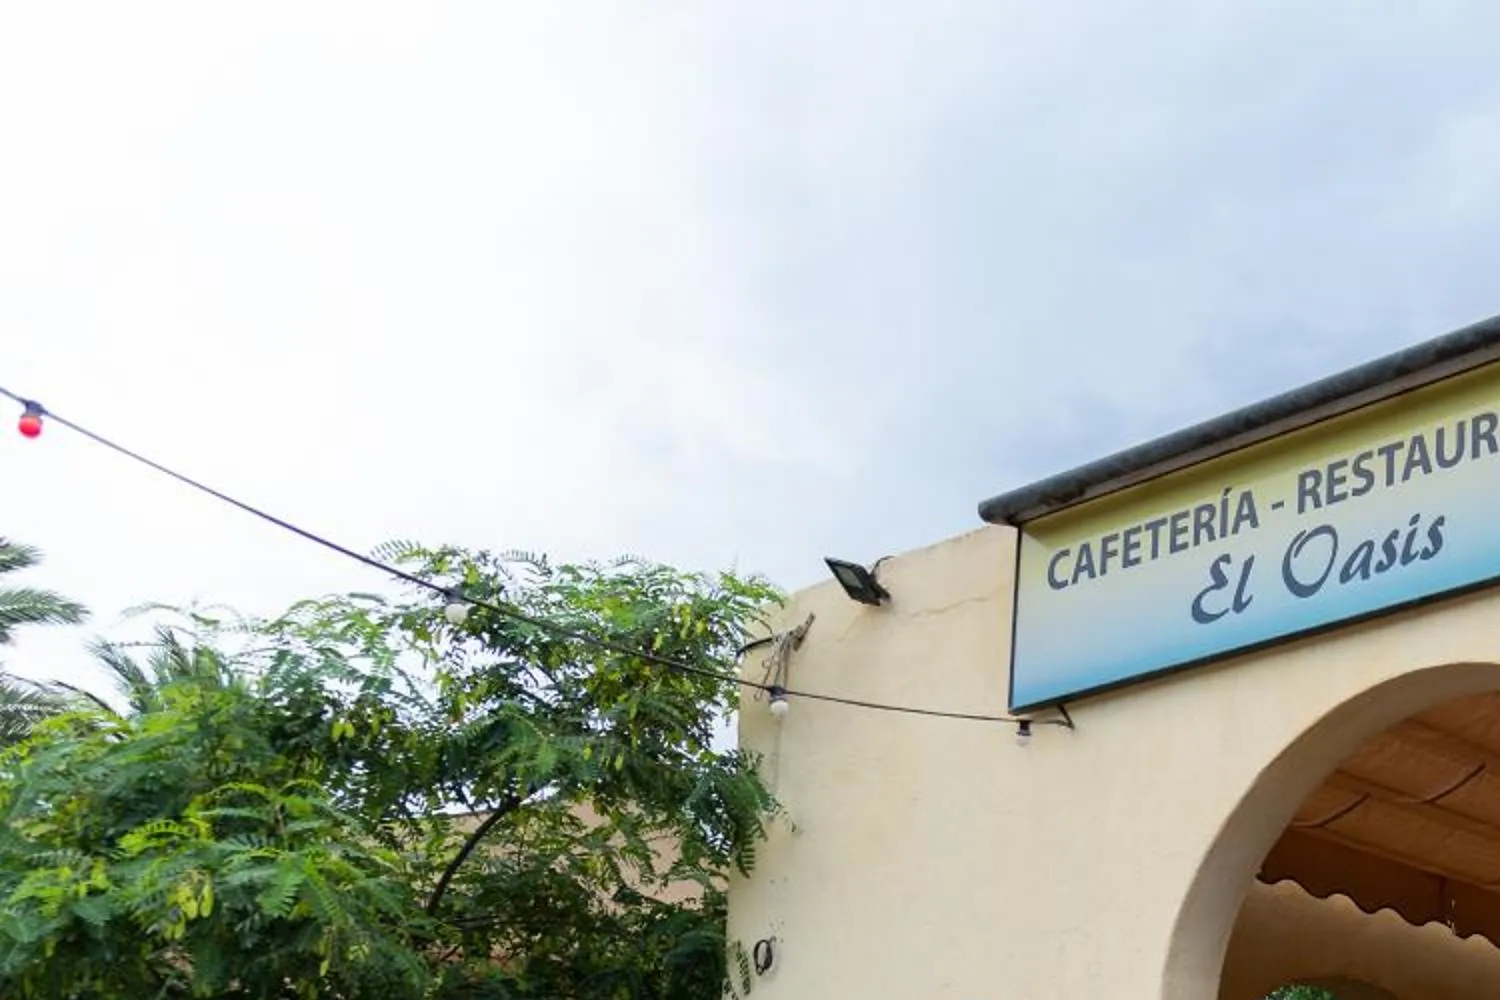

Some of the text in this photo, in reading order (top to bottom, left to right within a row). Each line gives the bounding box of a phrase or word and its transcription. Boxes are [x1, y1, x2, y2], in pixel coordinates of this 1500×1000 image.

[1047, 487, 1259, 590] CAFETERÍA
[1271, 500, 1285, 510] -
[1191, 513, 1446, 624] El Oasis
